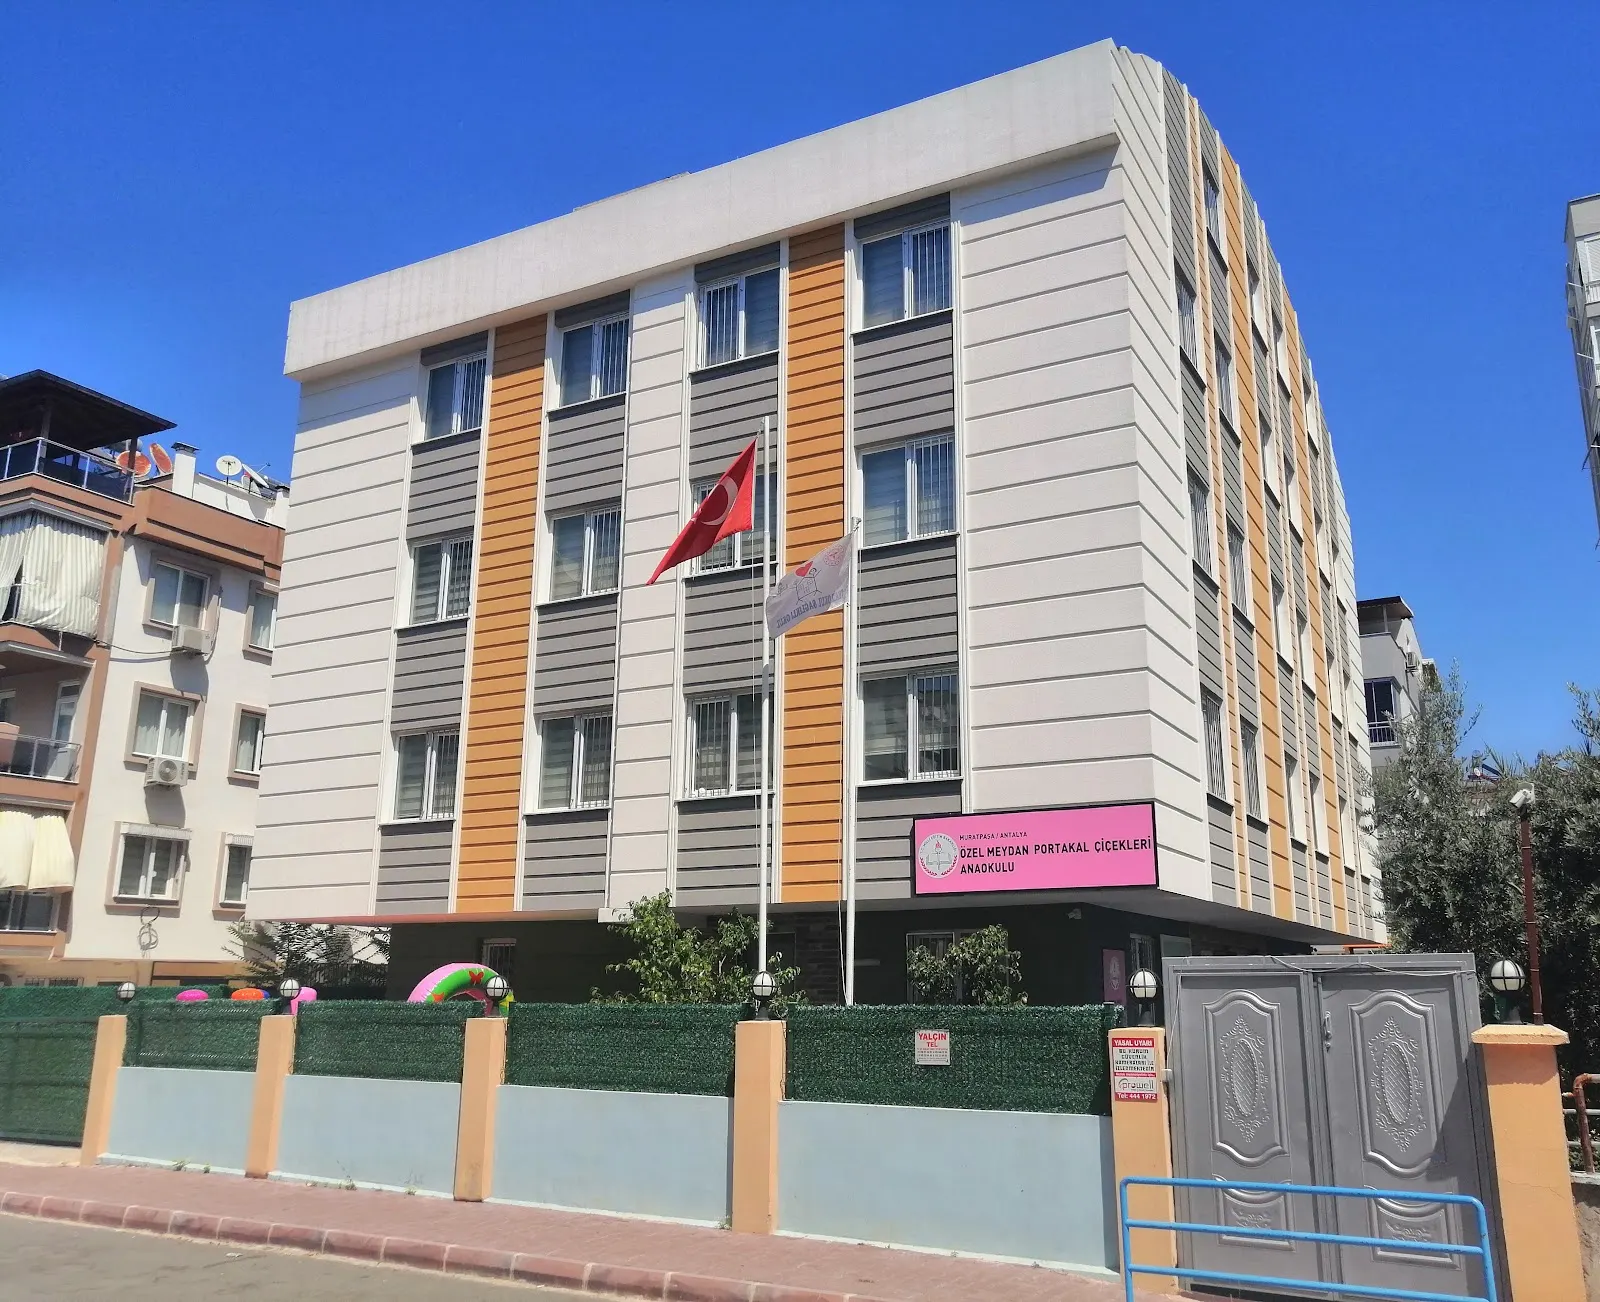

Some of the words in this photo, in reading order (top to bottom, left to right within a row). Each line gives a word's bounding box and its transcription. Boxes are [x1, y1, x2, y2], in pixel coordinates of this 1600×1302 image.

[1000, 831, 1028, 839] ANTALYA
[960, 845, 985, 858] ÖZEL
[987, 845, 1029, 857] MEYDAN
[1034, 842, 1089, 854] PORTAKAL
[1094, 835, 1151, 853] ÇİÇEKLERİ
[960, 861, 1015, 875] ANAOKULU
[918, 1033, 946, 1041] YALÇIN
[1121, 1079, 1154, 1090] prowell
